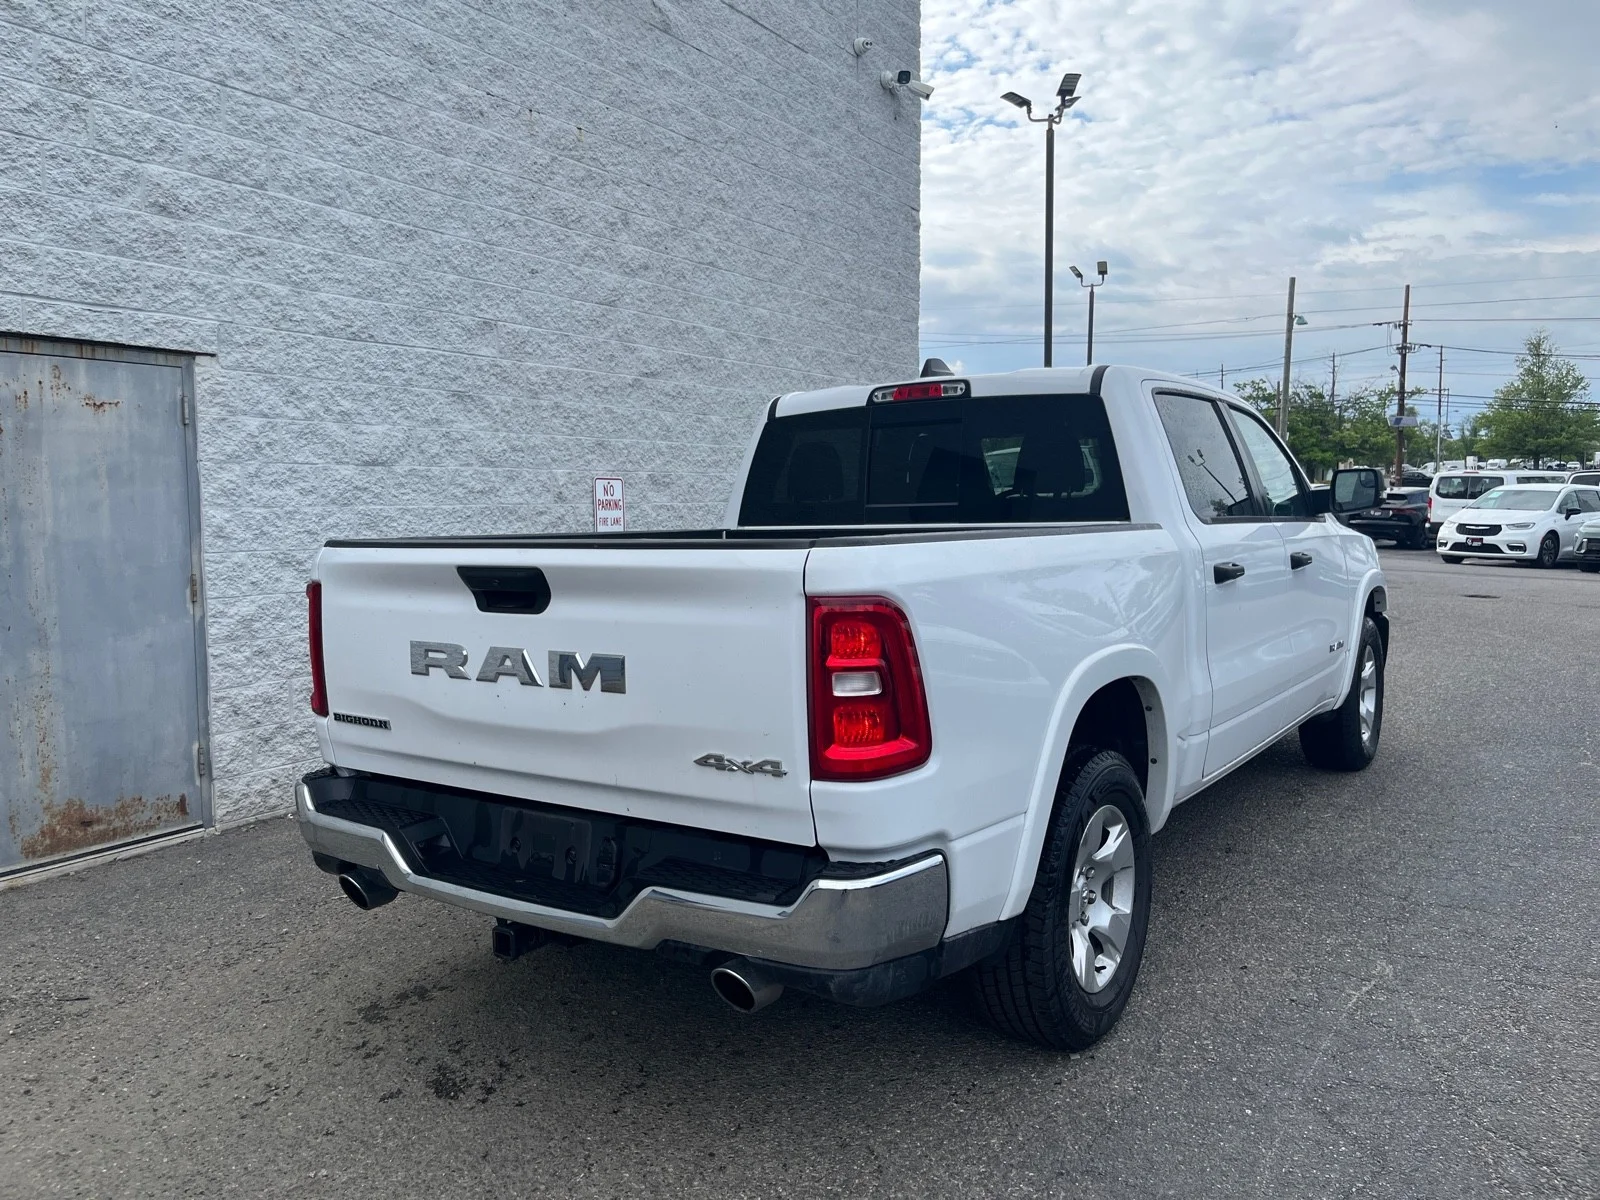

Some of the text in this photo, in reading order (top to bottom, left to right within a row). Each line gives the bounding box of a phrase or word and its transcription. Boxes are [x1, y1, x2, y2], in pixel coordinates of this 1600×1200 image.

[603, 484, 615, 497] NO
[597, 498, 622, 511] PARKING
[598, 517, 622, 527] FIRE LANE
[409, 640, 626, 694] RAM
